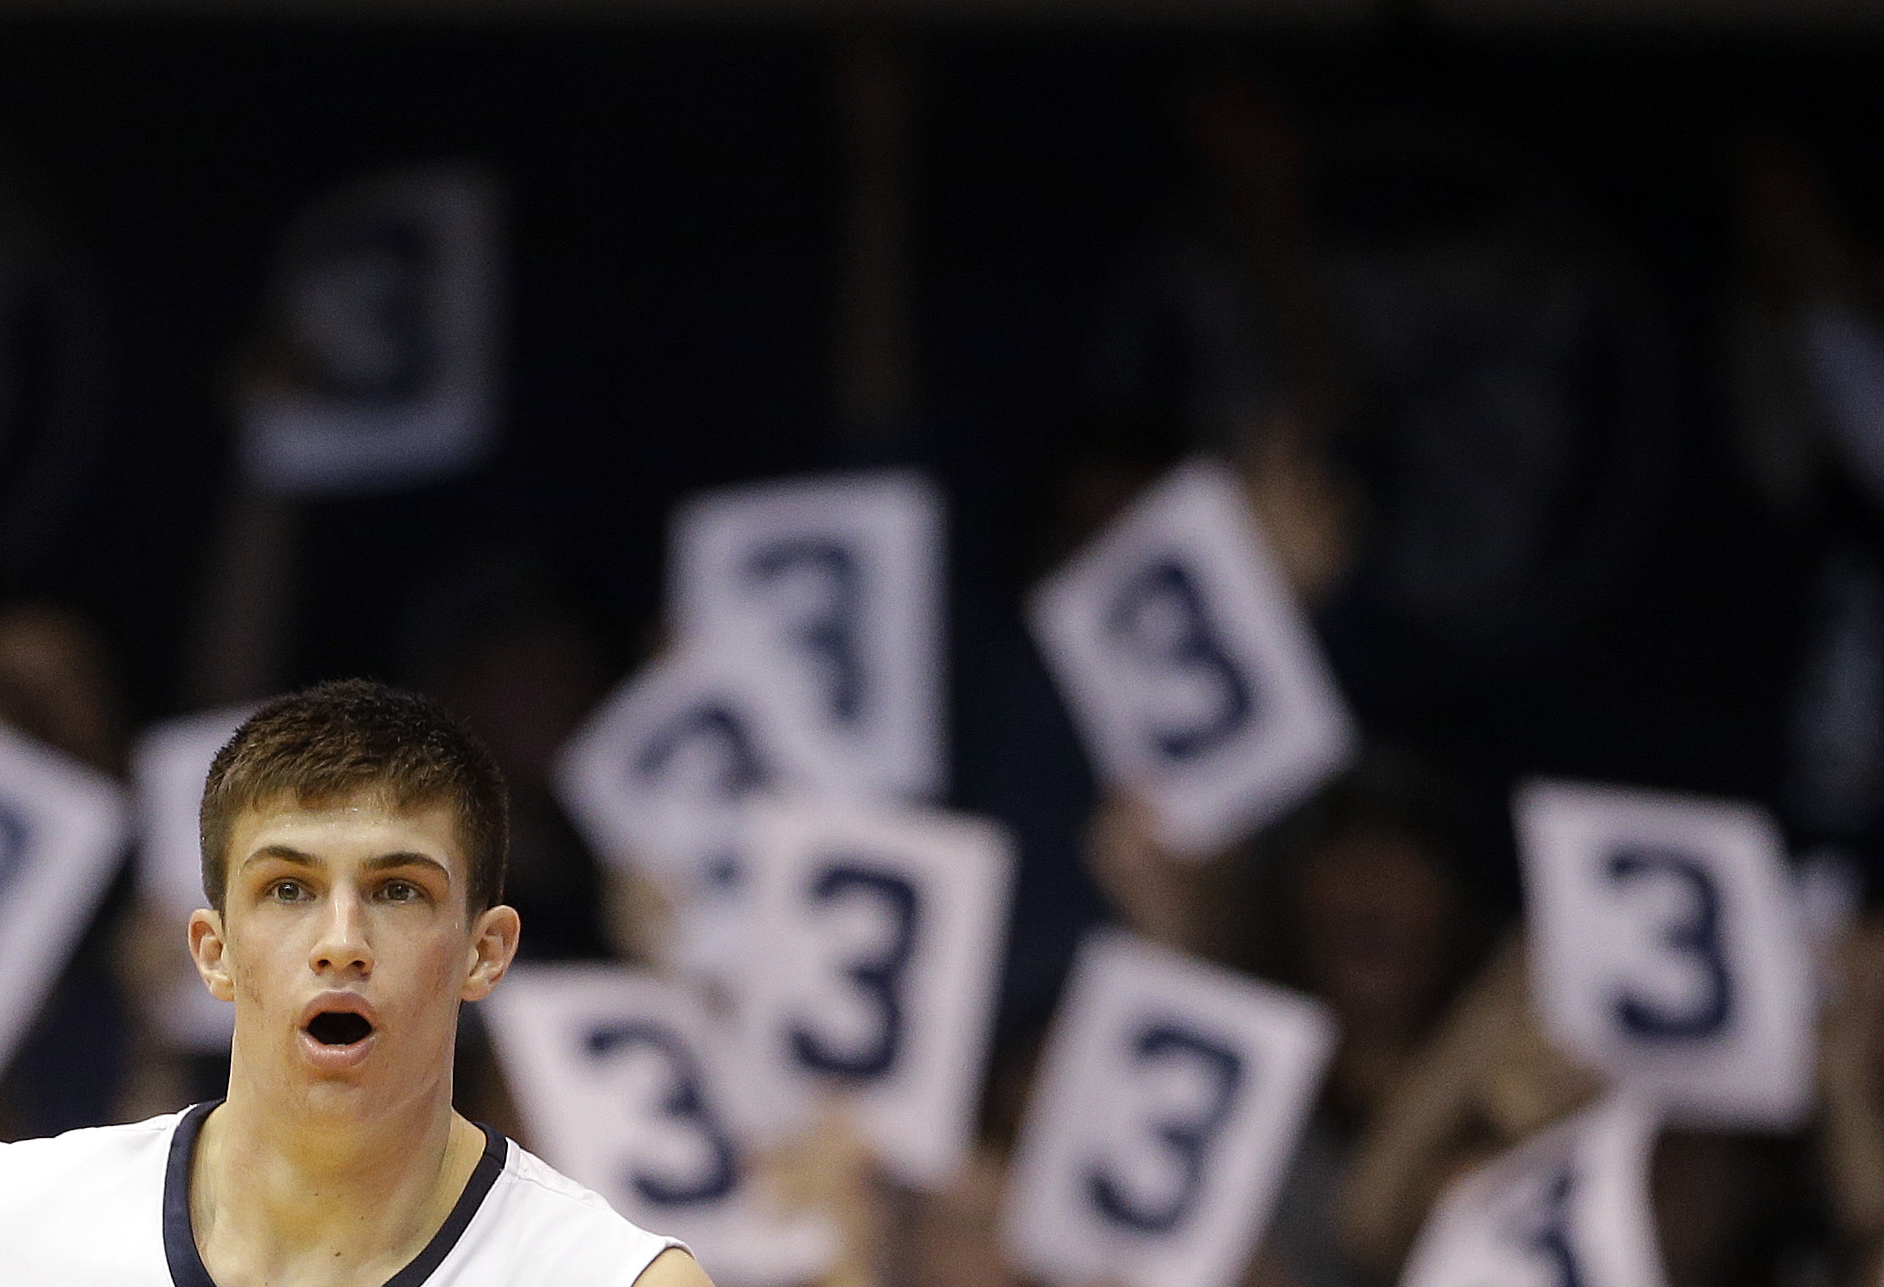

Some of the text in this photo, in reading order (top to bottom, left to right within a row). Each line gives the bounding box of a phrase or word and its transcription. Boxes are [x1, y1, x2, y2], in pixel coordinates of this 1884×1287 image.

[1098, 555, 1258, 765] 3
[788, 855, 924, 1082] 3
[1606, 843, 1734, 1043] 3
[581, 1013, 741, 1206] 3
[1086, 1015, 1246, 1235] 3
